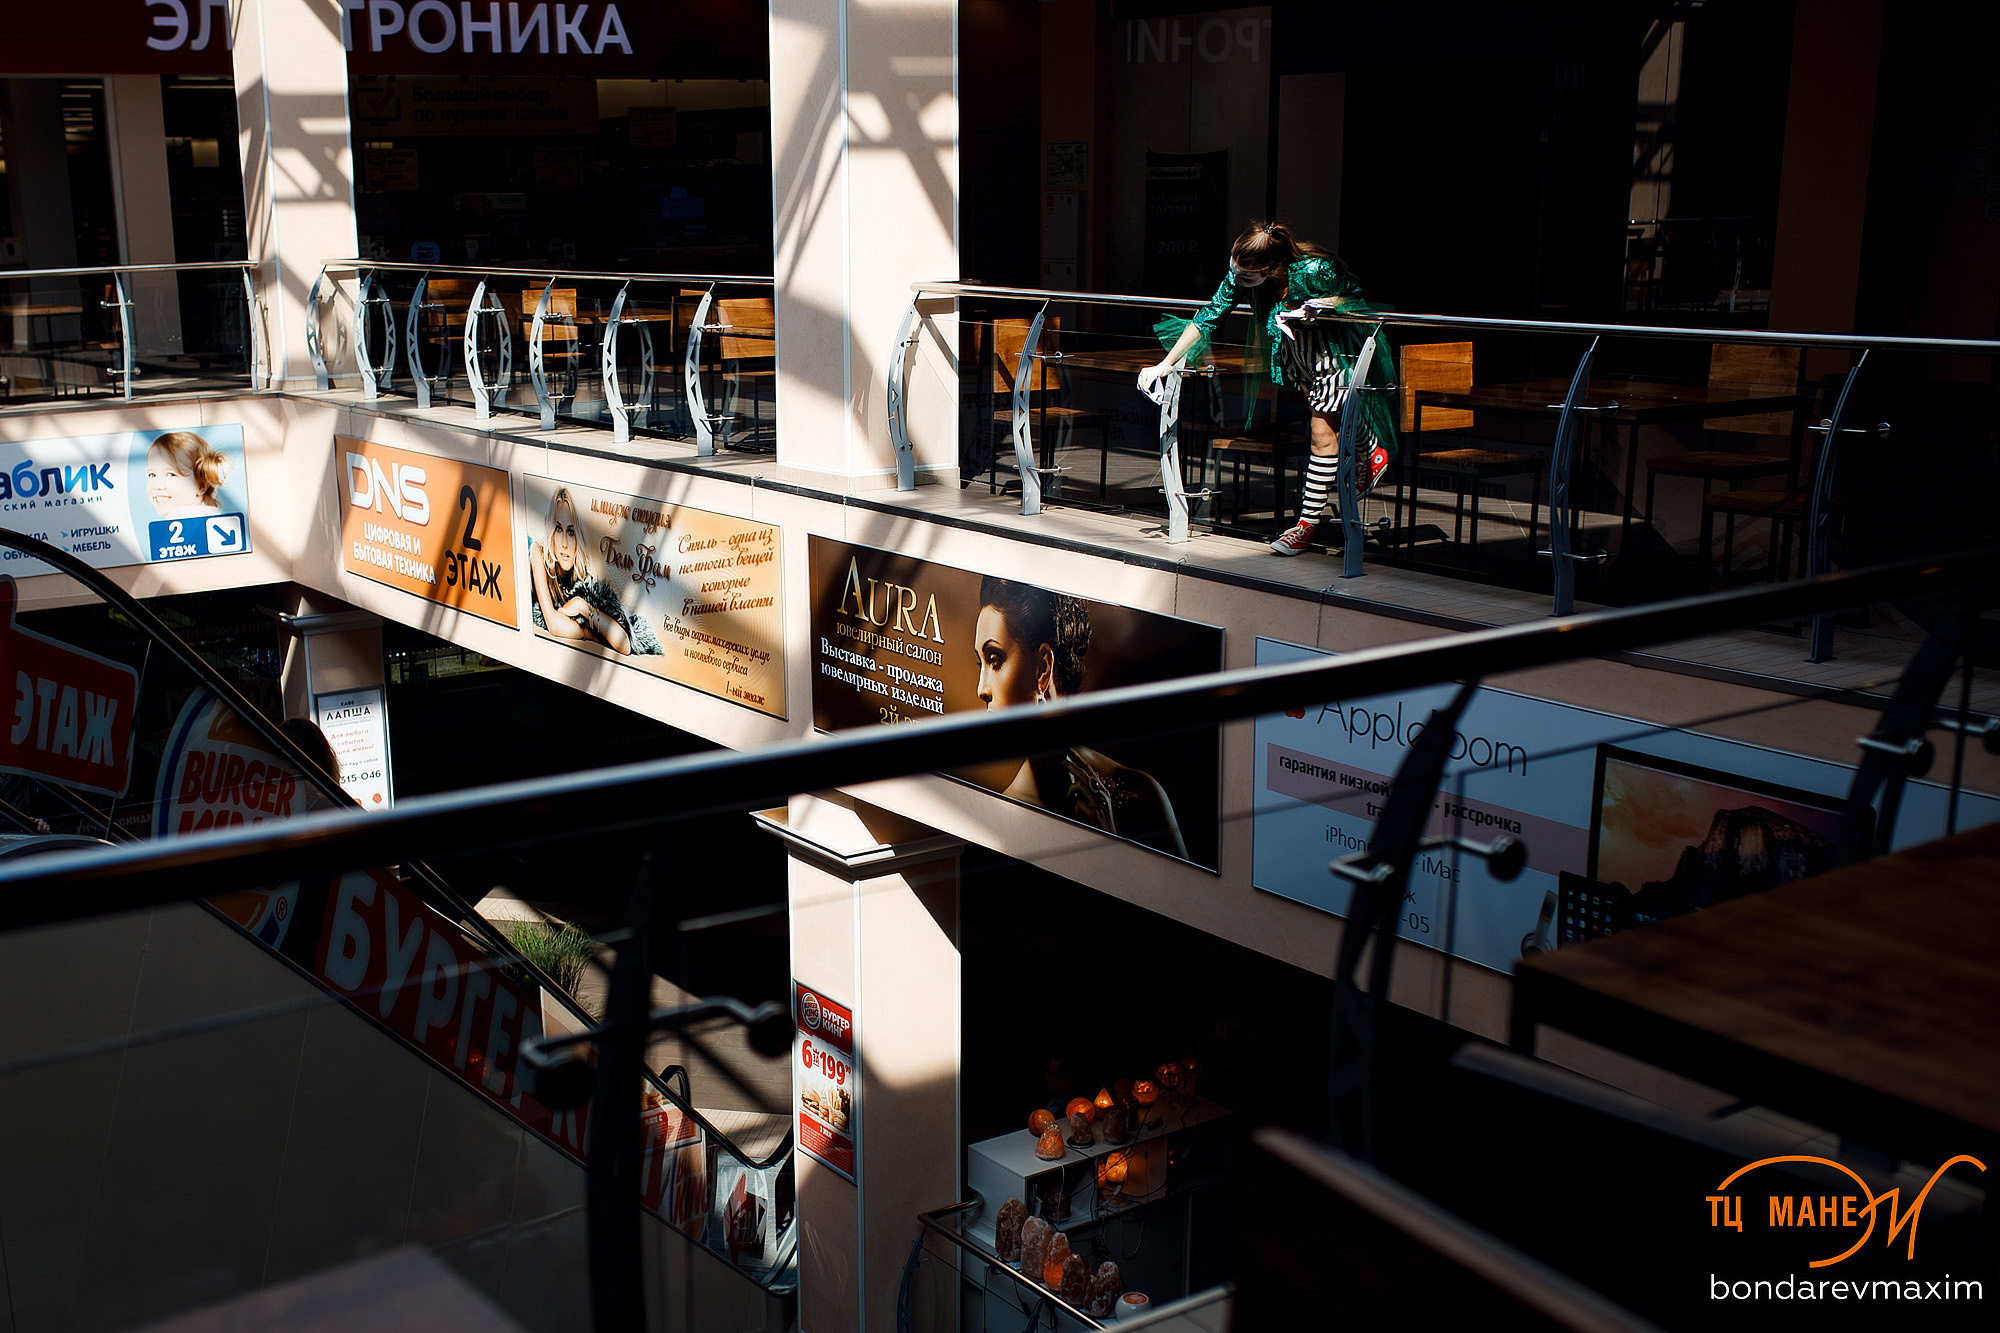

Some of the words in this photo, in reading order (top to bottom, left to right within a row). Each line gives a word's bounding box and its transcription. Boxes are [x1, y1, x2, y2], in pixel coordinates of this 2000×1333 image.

[0, 500, 36, 512] ский
[44, 496, 103, 508] магазин
[346, 452, 430, 527] DNS
[70, 525, 120, 539] ИГРУШКИ
[168, 521, 185, 544] 2
[460, 485, 482, 551] 2
[631, 507, 672, 535] студия
[72, 540, 112, 553] МЕБЕЛЬ
[159, 543, 197, 559] этаж
[364, 522, 412, 555] ЦИФРОВАЯ
[413, 536, 422, 557] И
[678, 534, 718, 554] Стиль
[728, 532, 757, 551] одна
[758, 528, 773, 546] из
[3, 550, 39, 561] ОБУВ
[353, 542, 393, 571] БЫТОВАЯ
[394, 554, 437, 585] ТЕХНИКА
[678, 555, 734, 576] немногих
[736, 546, 774, 567] вещей
[445, 550, 502, 601] ЭТАЖ
[701, 575, 751, 595] которые
[729, 592, 774, 611] власти
[837, 555, 945, 644] AURA
[691, 630, 750, 656] парикмахерских
[836, 622, 904, 655] ювелирный
[905, 643, 943, 666] салон
[820, 636, 877, 672] Выставка
[886, 664, 944, 694] продажа
[821, 662, 890, 697] ювелирных
[891, 686, 945, 715] изделий
[10, 669, 119, 767] ЭТАЖ
[327, 706, 371, 720] ЛАПША
[177, 750, 297, 820] BURGER
[1278, 755, 1336, 783] гарантия
[1339, 770, 1391, 798] низкой
[1444, 801, 1522, 835] рассрочка
[1421, 854, 1461, 883] iMac
[822, 1007, 850, 1030] БУРГЕР
[822, 1019, 844, 1037] КИНГ
[802, 1039, 812, 1069] 6
